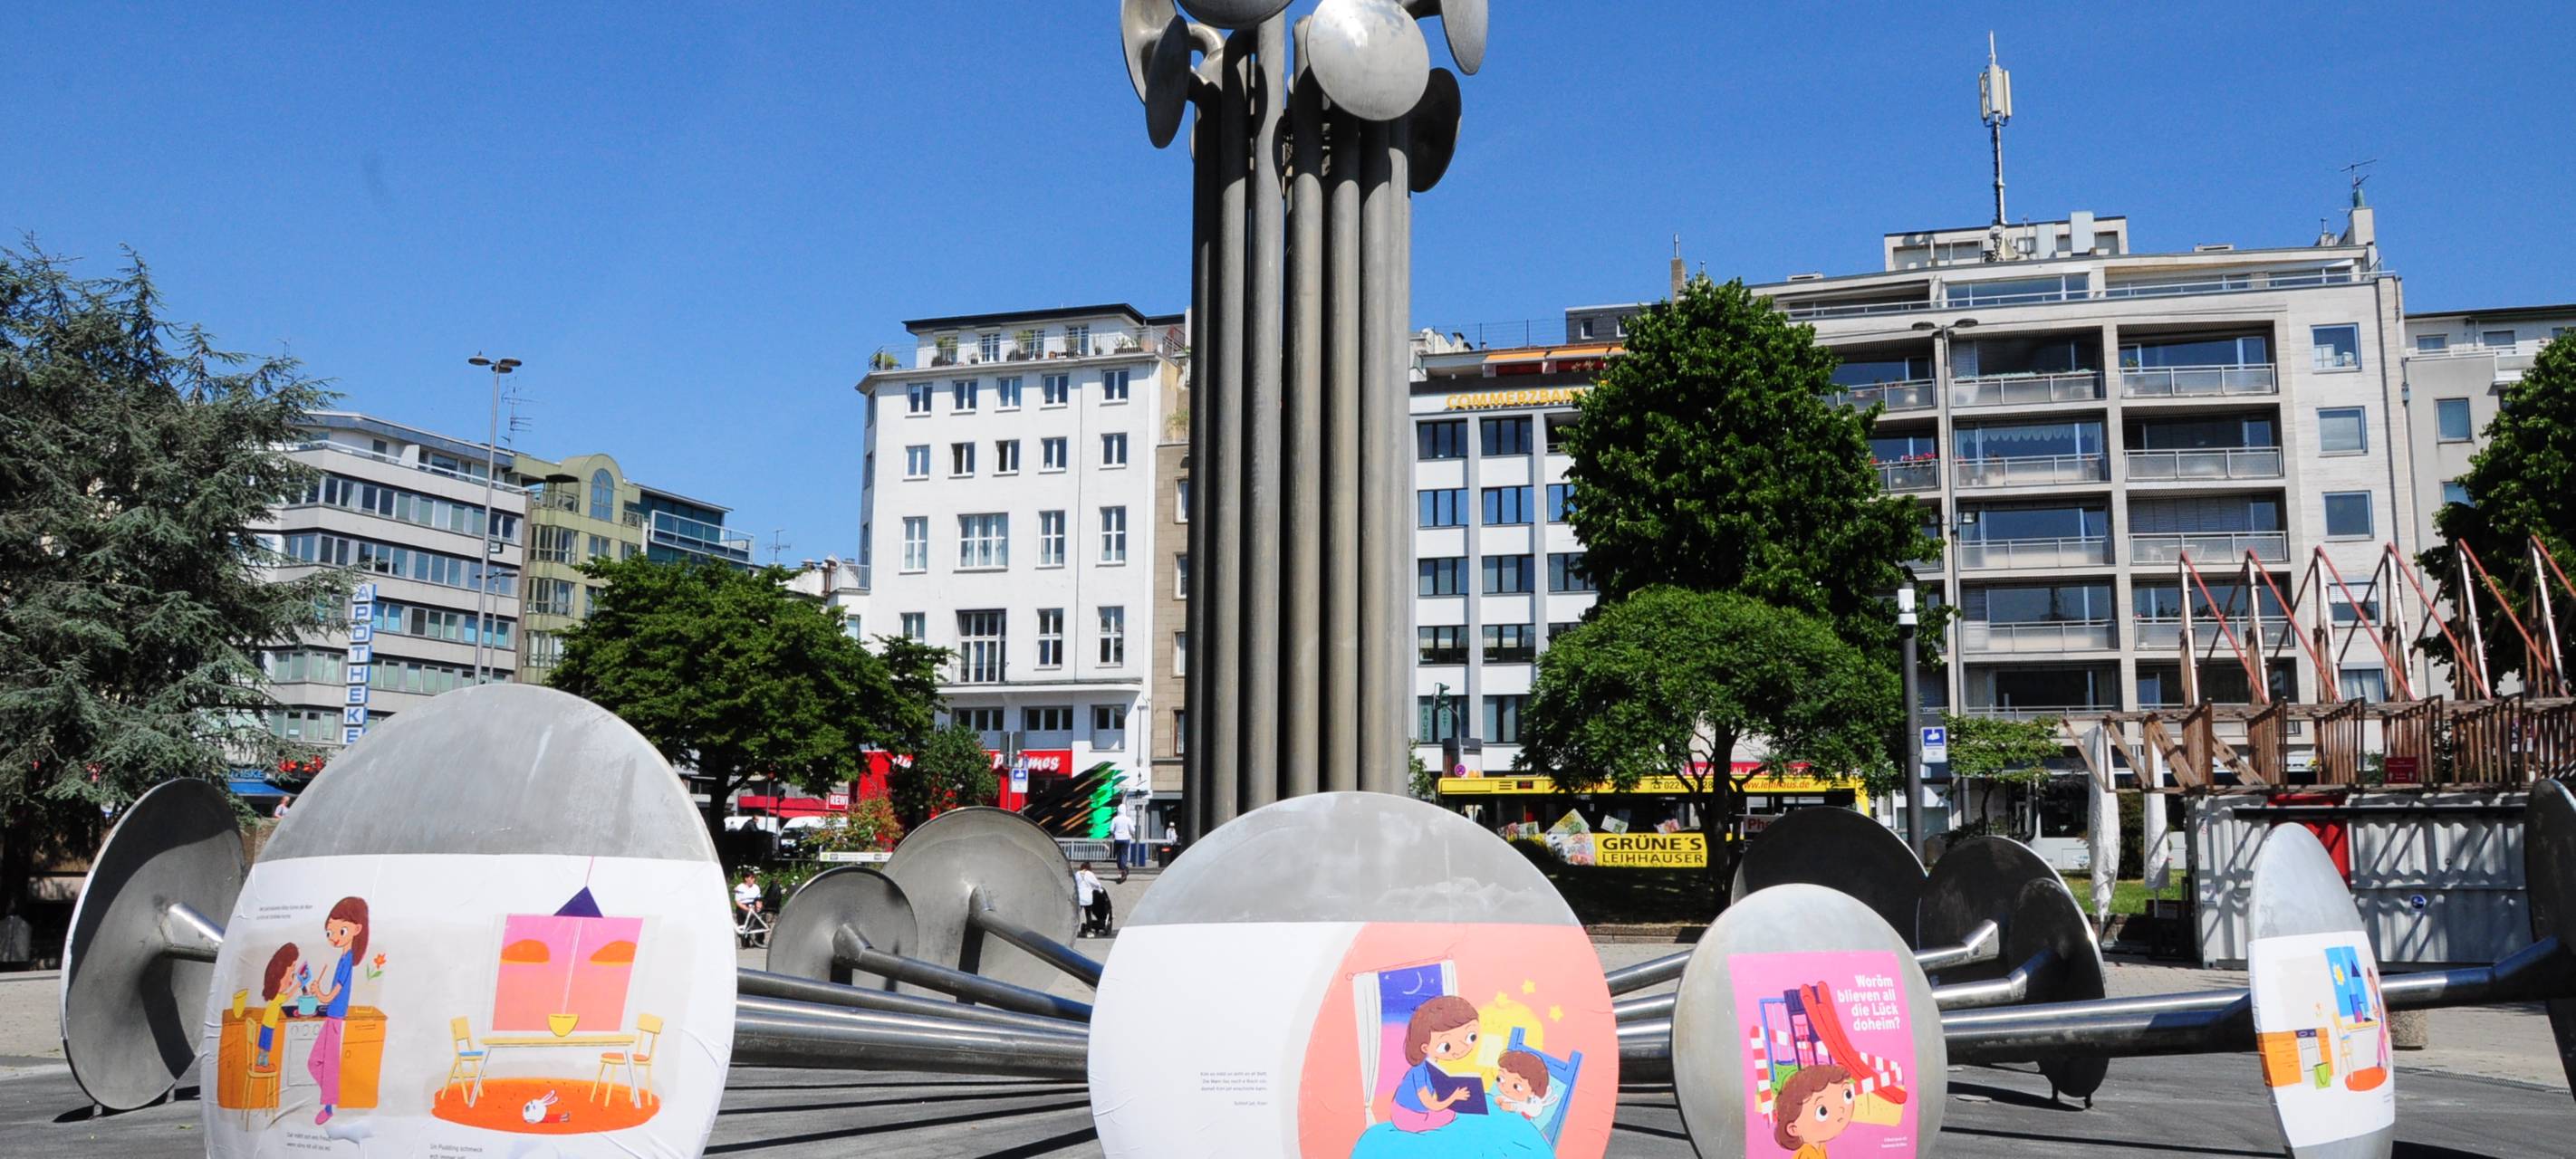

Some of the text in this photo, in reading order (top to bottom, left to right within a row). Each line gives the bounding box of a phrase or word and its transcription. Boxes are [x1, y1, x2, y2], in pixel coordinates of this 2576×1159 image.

[346, 585, 370, 743] APOTHEKE
[1837, 989, 1880, 1003] blieven
[1851, 1003, 1870, 1017] die
[1853, 1016, 1900, 1031] doheim?
